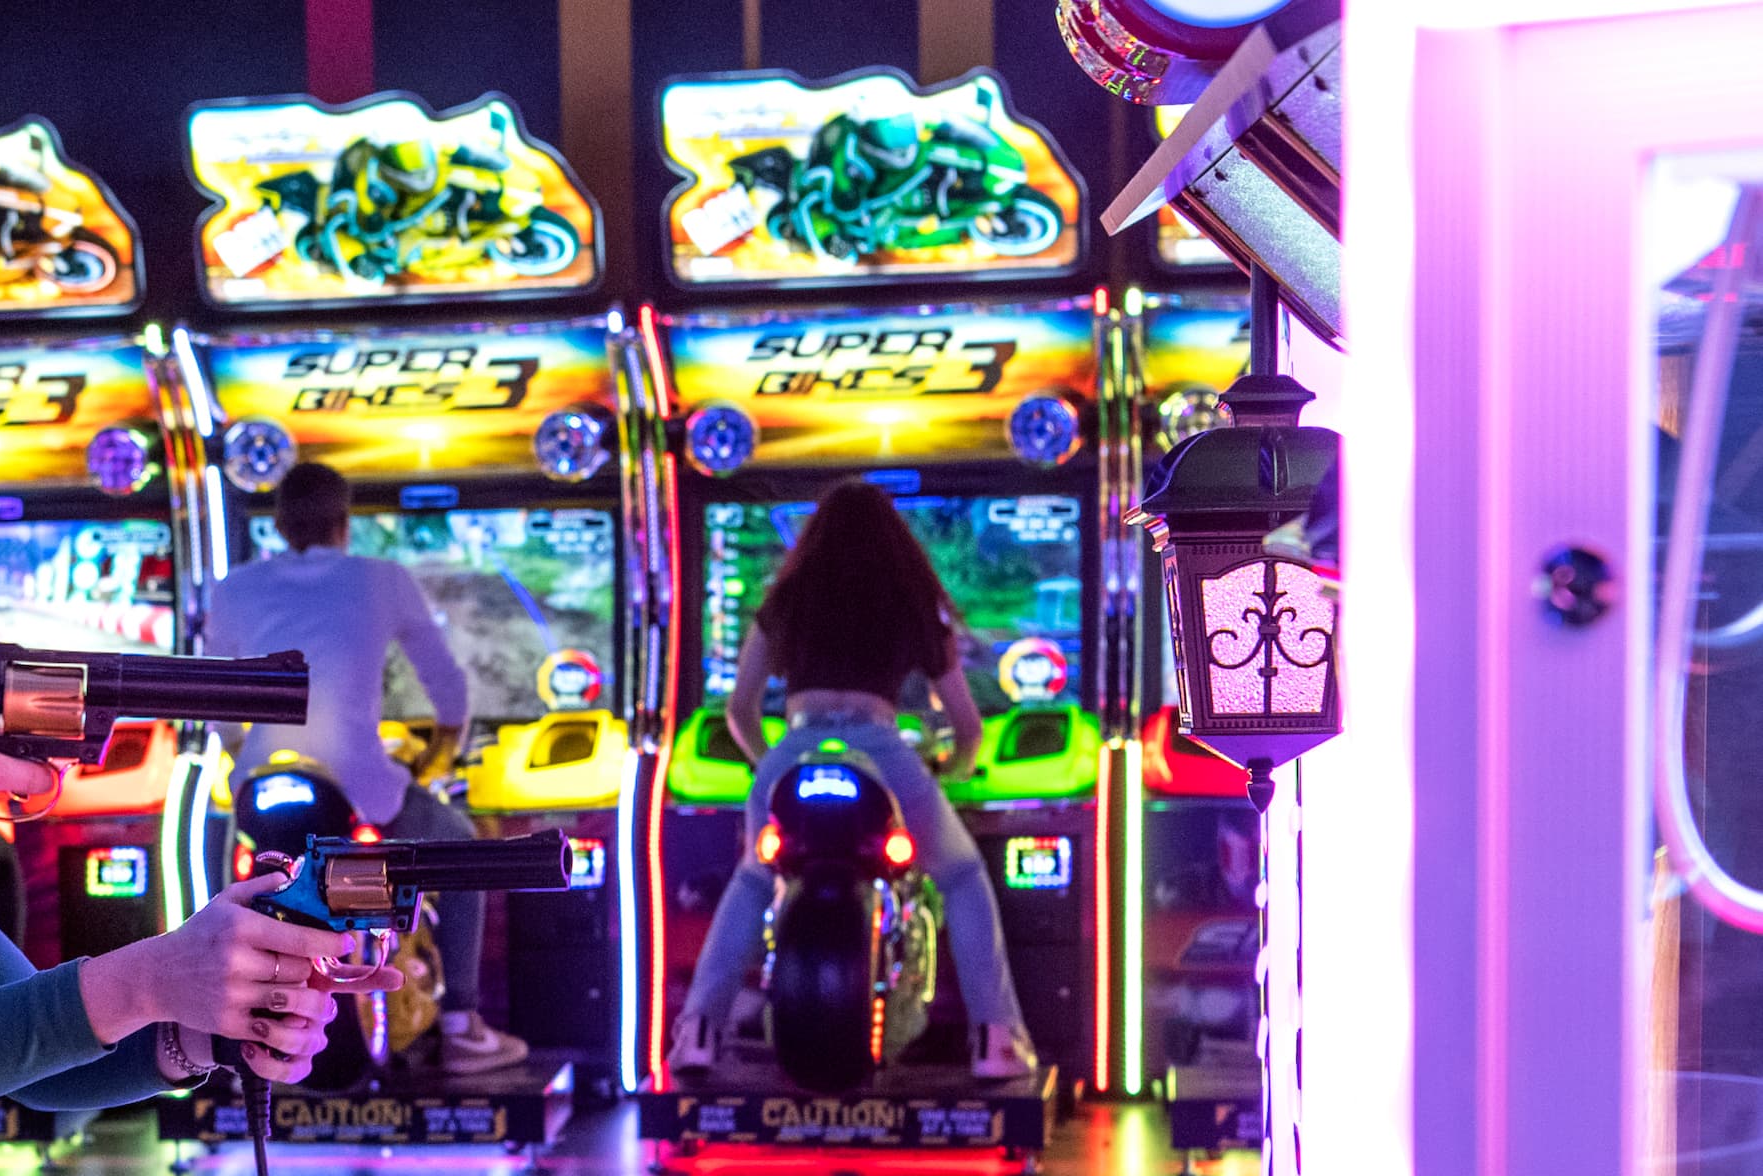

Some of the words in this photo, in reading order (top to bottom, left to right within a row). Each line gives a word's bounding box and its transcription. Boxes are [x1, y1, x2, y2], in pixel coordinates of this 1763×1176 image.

[747, 329, 952, 361] SUPER
[283, 347, 478, 378] SUPER
[756, 366, 933, 394] BIKES
[919, 340, 1018, 395] 3
[3, 374, 86, 426] 3
[293, 382, 461, 411] BIKES
[448, 357, 540, 411] 3
[274, 1100, 412, 1127] CAUTION!
[762, 1099, 906, 1128] CAUTION!
